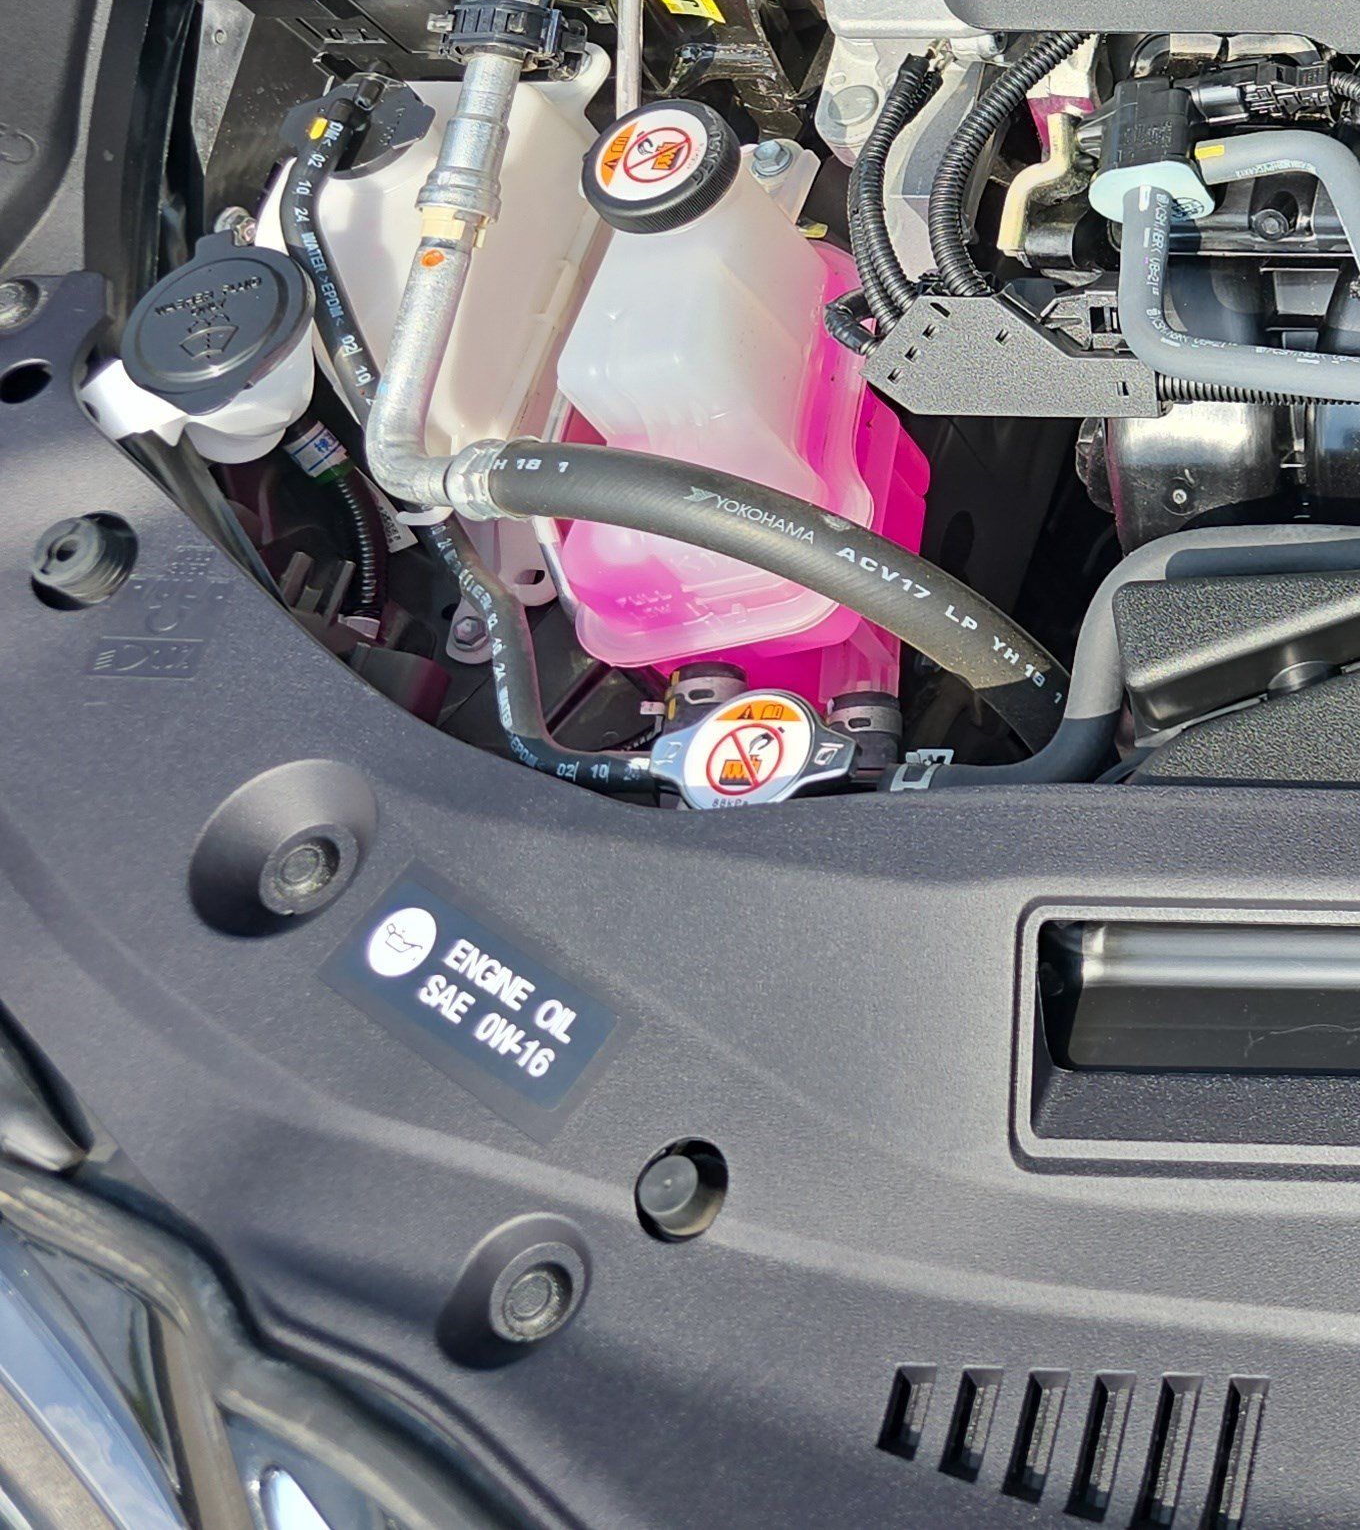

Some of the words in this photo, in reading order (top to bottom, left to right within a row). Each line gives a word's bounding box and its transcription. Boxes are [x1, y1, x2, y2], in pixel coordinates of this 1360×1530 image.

[153, 290, 214, 316] WASHER
[222, 276, 263, 295] FLUID
[301, 231, 327, 274] WATER
[713, 492, 816, 546] YOKOHAMA
[836, 546, 932, 600] ACV17
[944, 604, 979, 631] LP
[992, 635, 1021, 665] YH
[417, 974, 477, 1025] SAE
[474, 1012, 556, 1078] 0W-16
[443, 938, 537, 1012] ENGINE
[534, 998, 578, 1045] OIL
